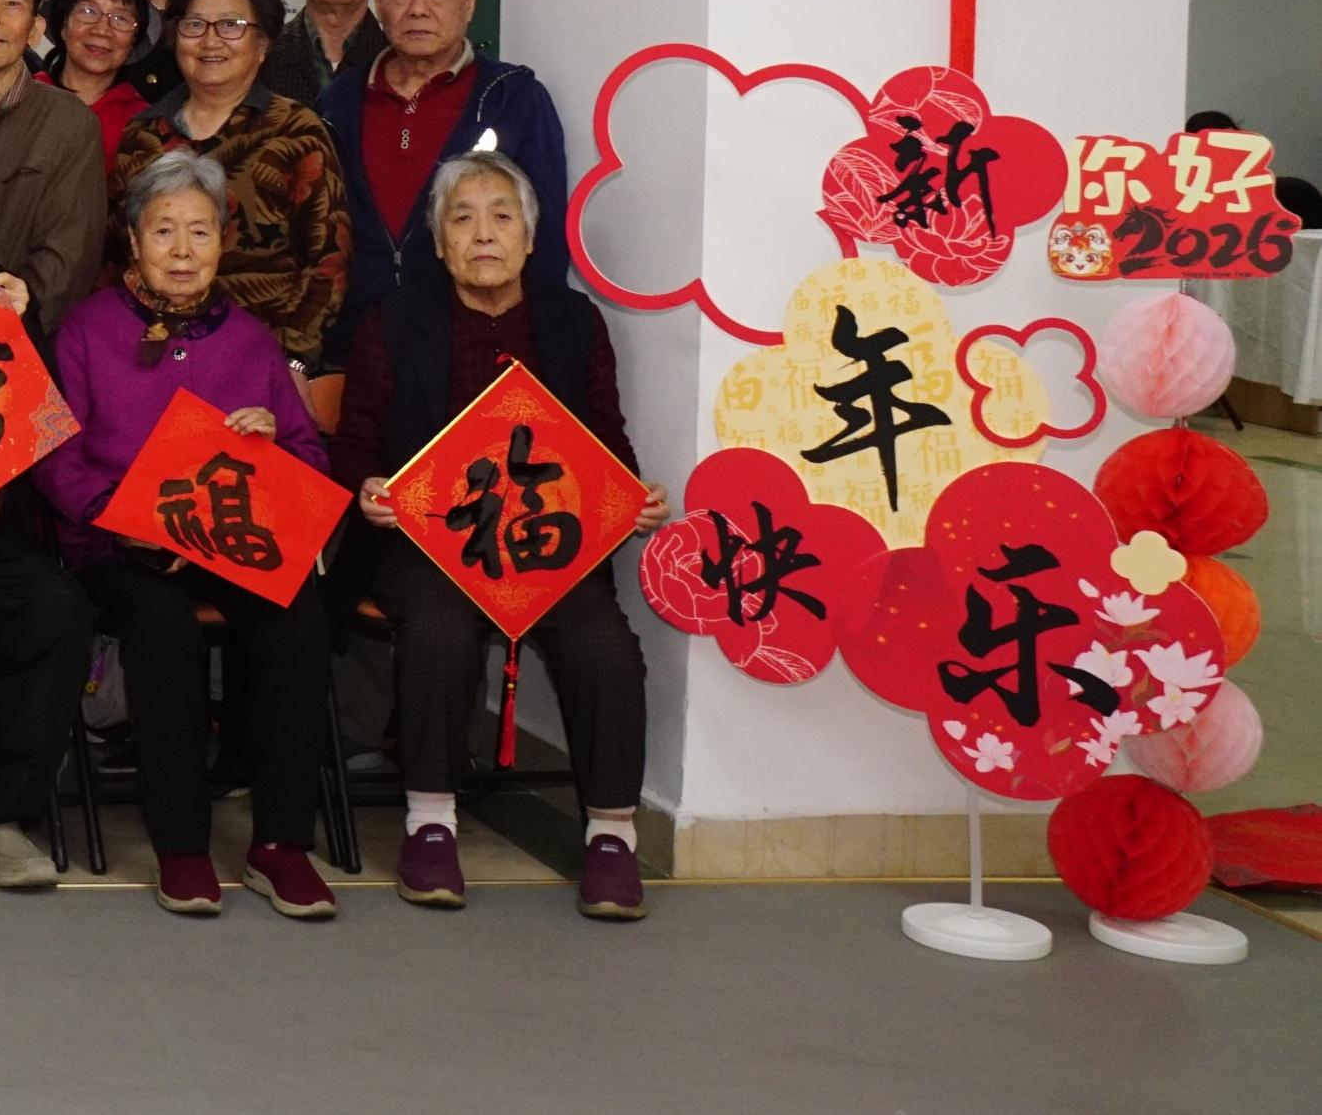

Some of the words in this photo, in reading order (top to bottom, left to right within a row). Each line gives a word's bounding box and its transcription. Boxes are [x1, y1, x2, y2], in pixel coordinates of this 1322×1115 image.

[877, 115, 1001, 239] 新
[1064, 132, 1274, 216] 你好
[1114, 206, 1298, 276] 2026
[800, 304, 952, 513] 年
[157, 451, 284, 572] 福
[425, 425, 583, 579] 福
[700, 501, 827, 627] 快
[938, 544, 1120, 727] 乐
